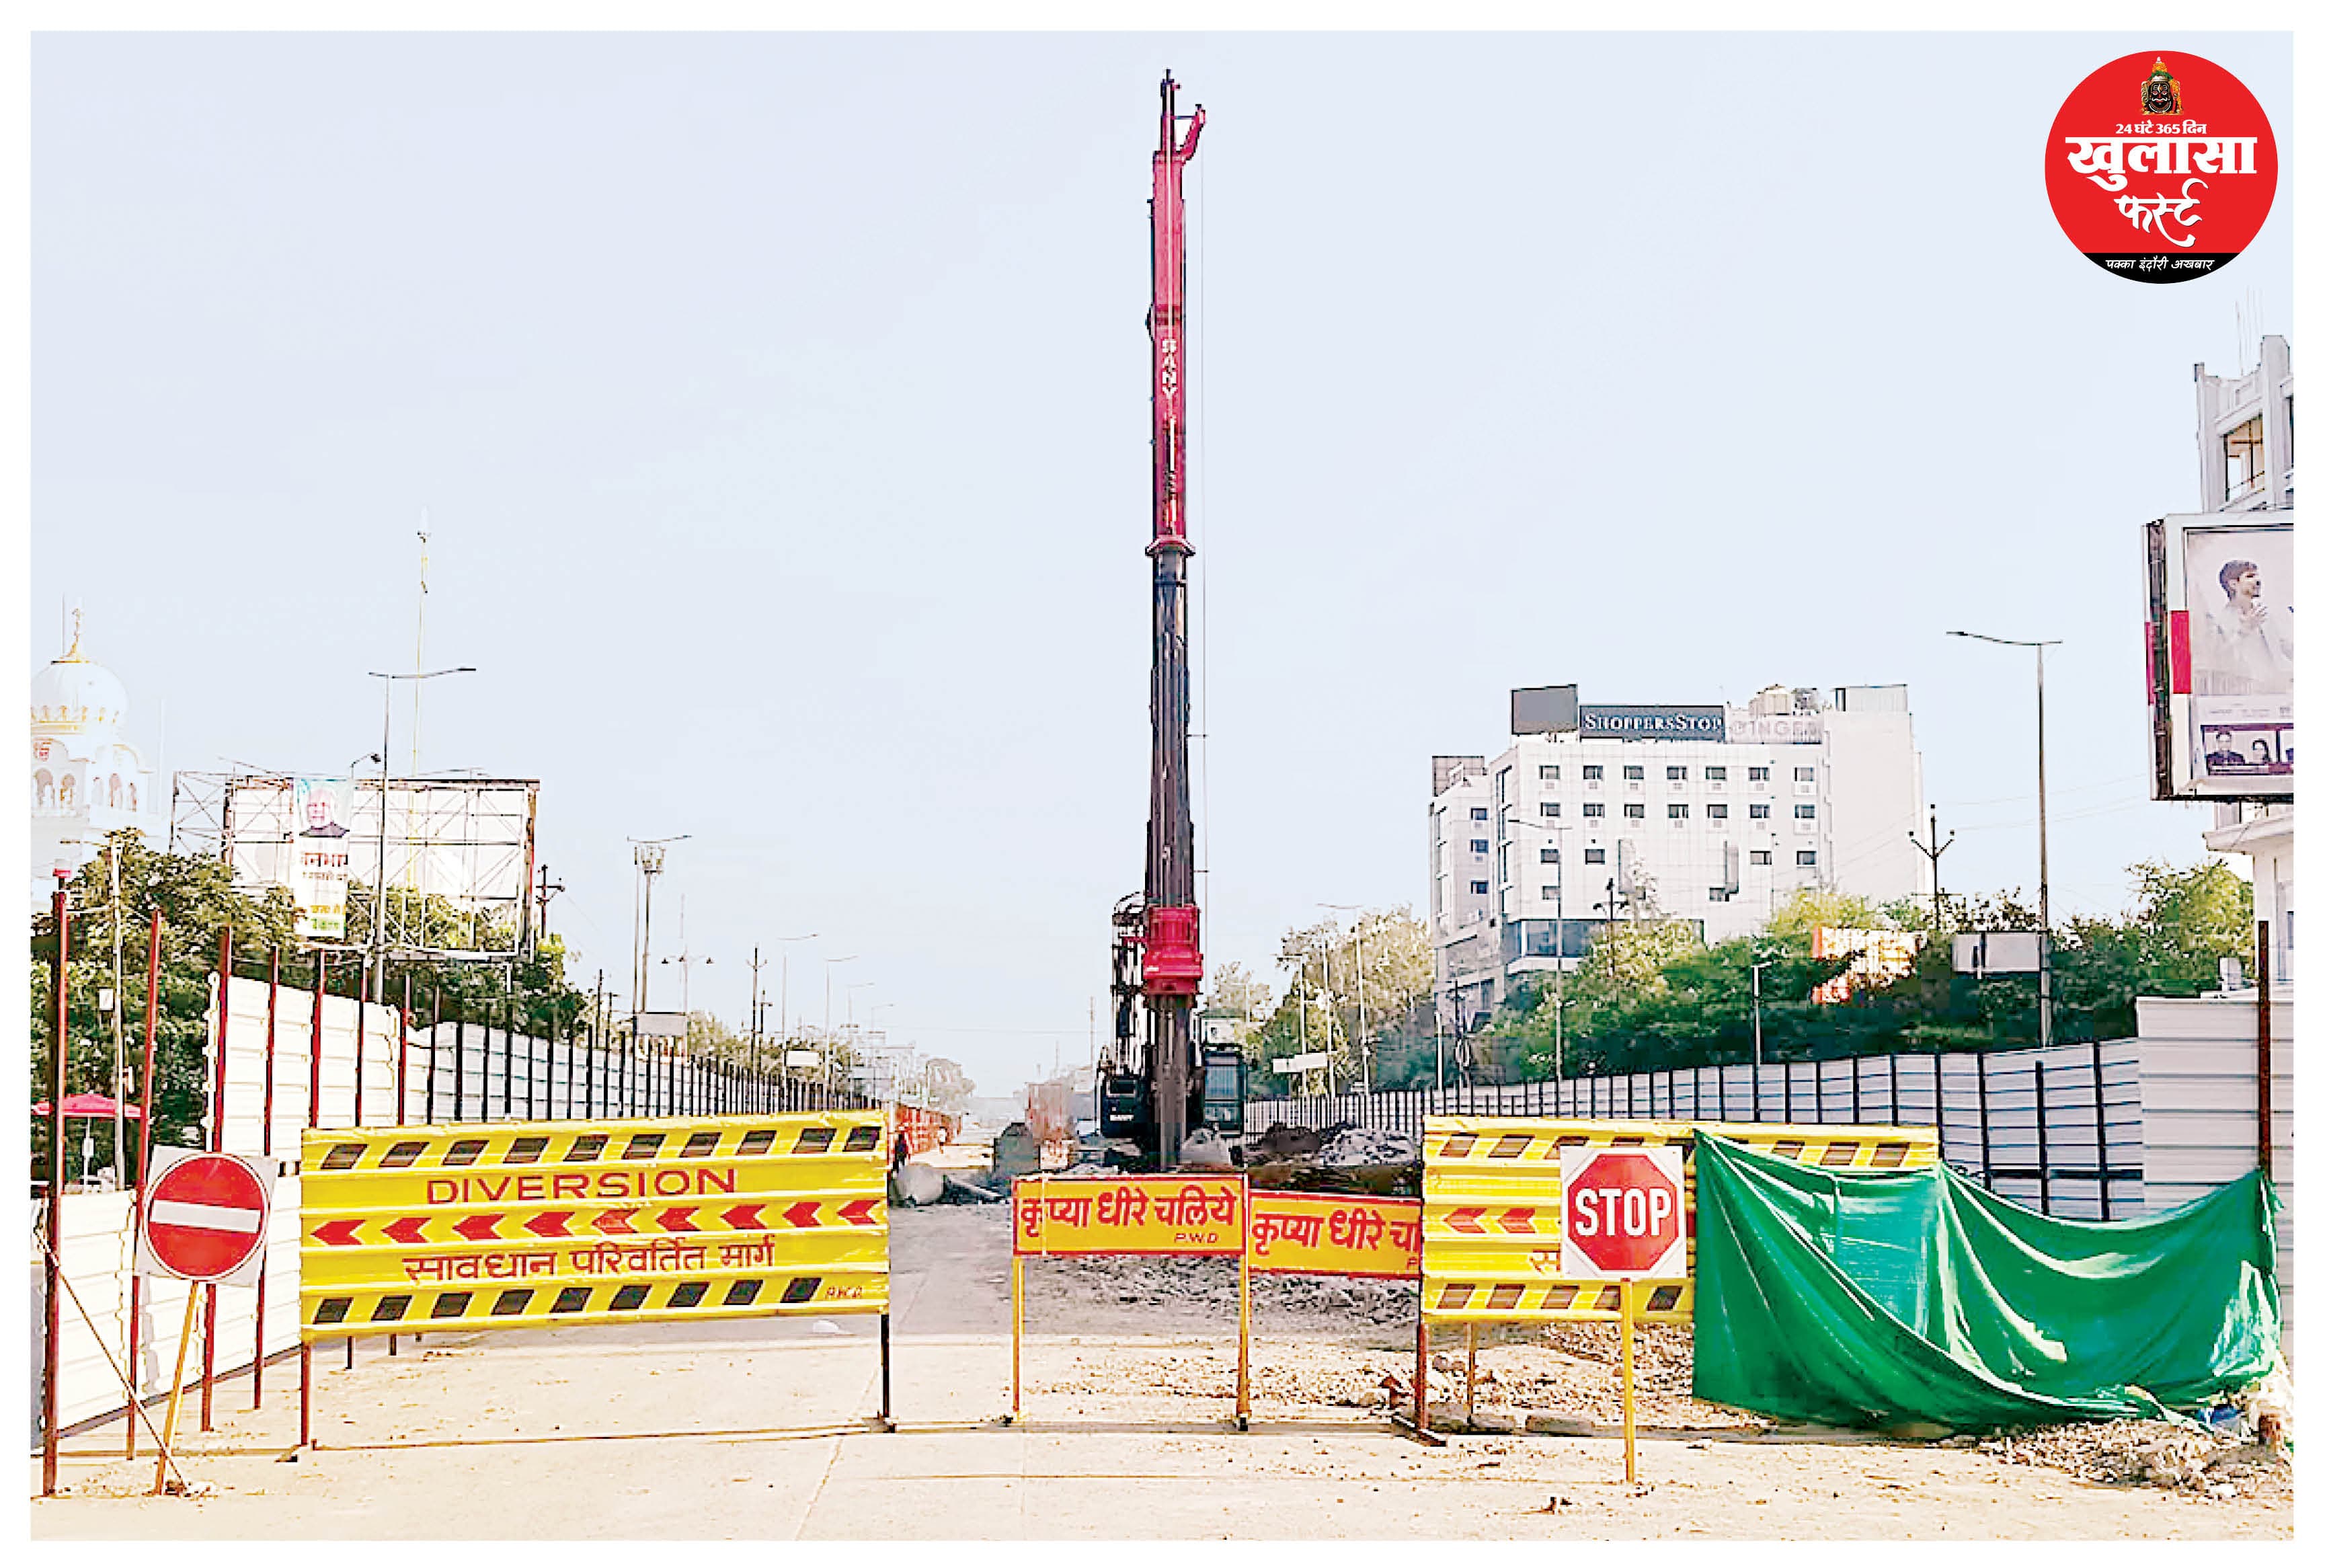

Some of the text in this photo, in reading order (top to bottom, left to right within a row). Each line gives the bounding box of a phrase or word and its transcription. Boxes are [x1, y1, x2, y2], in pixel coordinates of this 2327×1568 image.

[426, 1168, 736, 1205] DIVERSION
[1020, 1183, 1238, 1238] कृप्या धीरे चलिये
[1251, 1214, 1325, 1256] कृप्या
[1329, 1208, 1386, 1251] धीरे
[1575, 1187, 1671, 1237] STOP
[402, 1234, 776, 1282] सावधान परिवर्तित मार्ग
